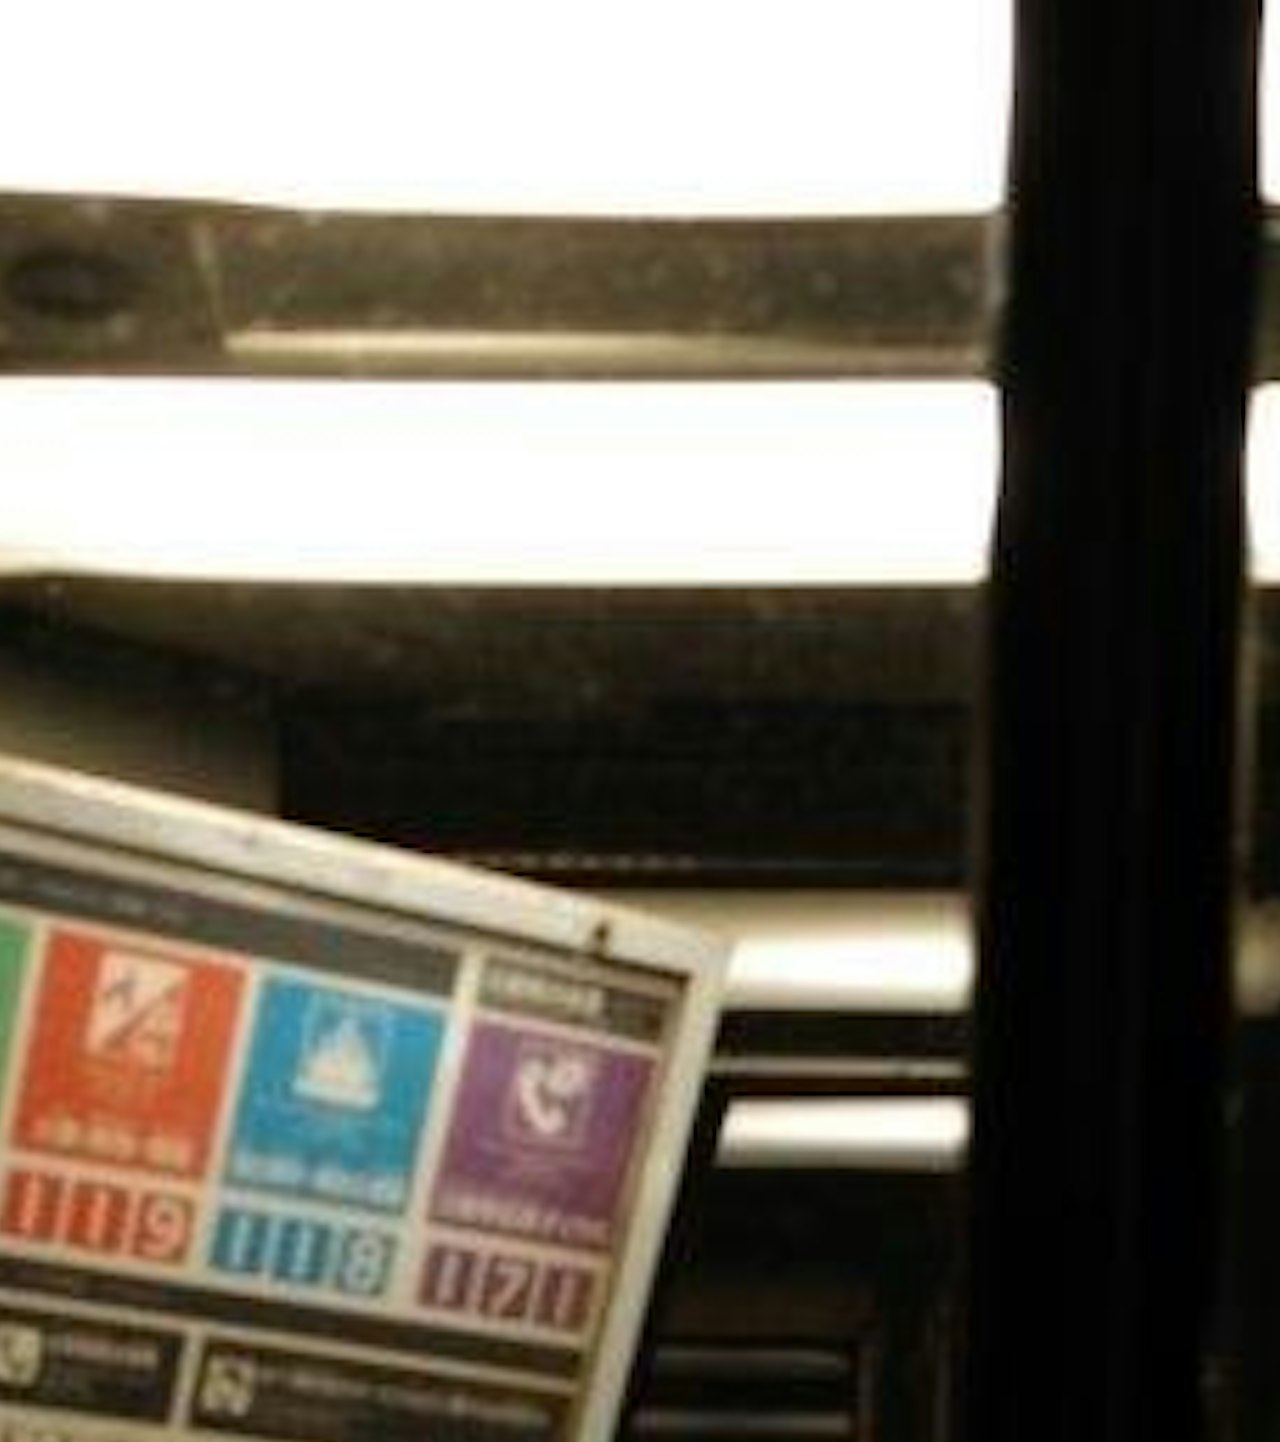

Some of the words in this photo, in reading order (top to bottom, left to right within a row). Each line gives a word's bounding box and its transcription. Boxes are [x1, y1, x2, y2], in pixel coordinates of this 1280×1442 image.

[16, 1172, 188, 1261] 119
[228, 1212, 387, 1292] 118
[436, 1248, 586, 1327] 171
